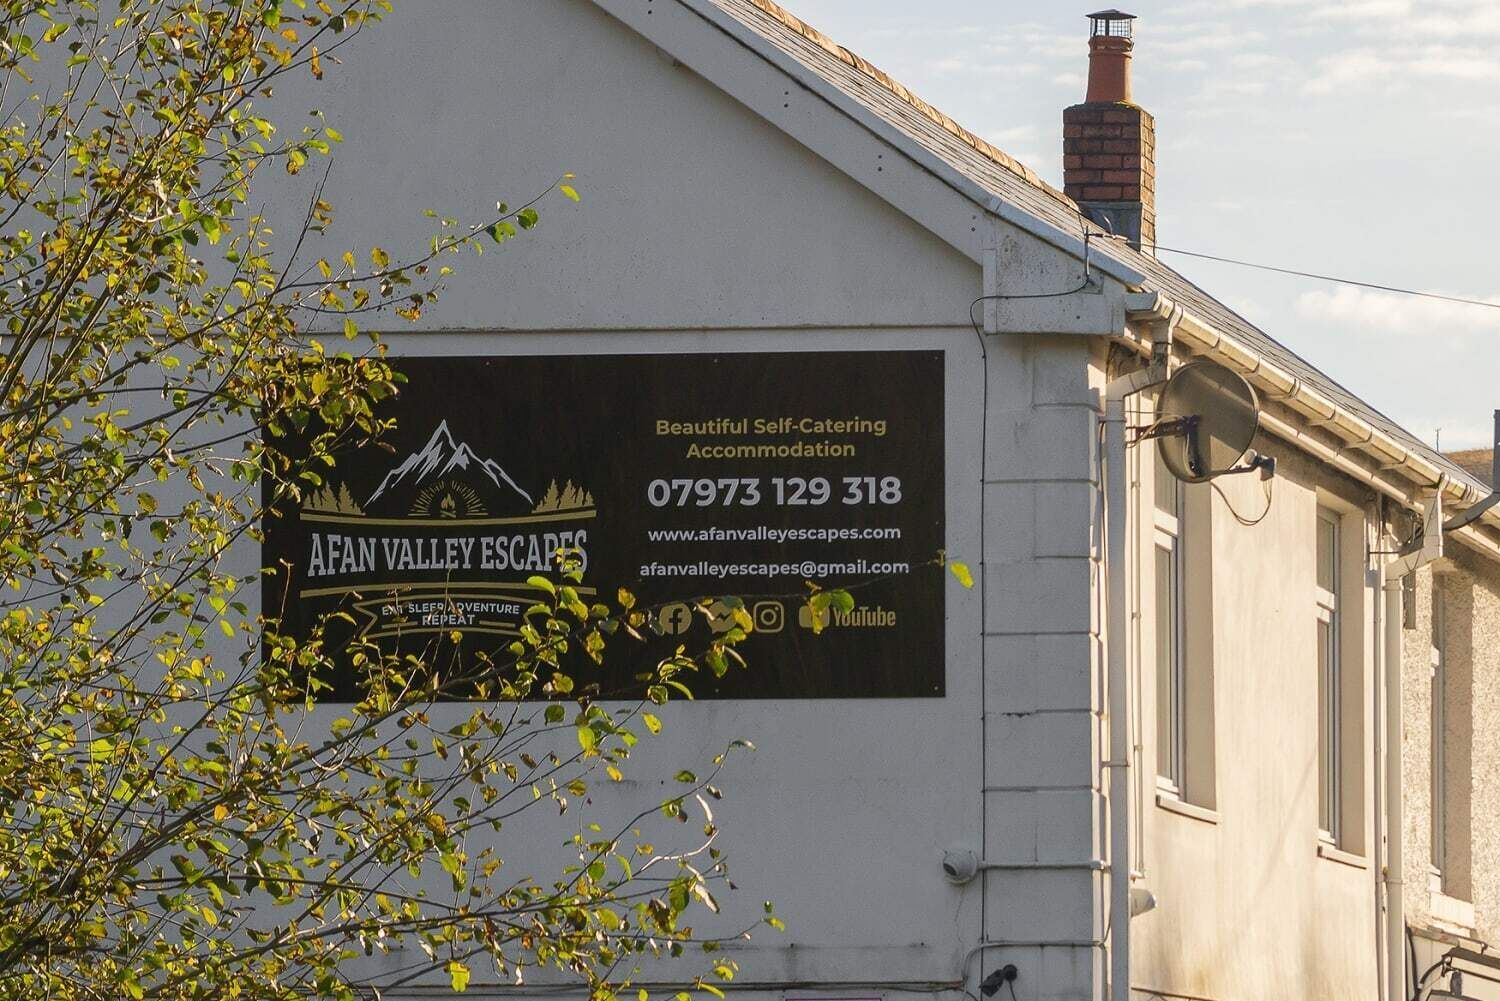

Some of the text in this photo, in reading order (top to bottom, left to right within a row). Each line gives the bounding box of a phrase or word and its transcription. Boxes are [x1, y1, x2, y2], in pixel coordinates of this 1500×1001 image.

[655, 416, 887, 436] Beautiful Self-Catering
[686, 440, 856, 458] Accommodation
[647, 476, 902, 507] 07973 129 318
[648, 526, 901, 543] www.afanvalleyescapes.com
[307, 529, 588, 577] AFAN VALLEY ESCAPES
[640, 560, 909, 578] afanvalleyescapes@gmail.com
[422, 614, 475, 626] REPEAT
[833, 606, 896, 627] YouTube
